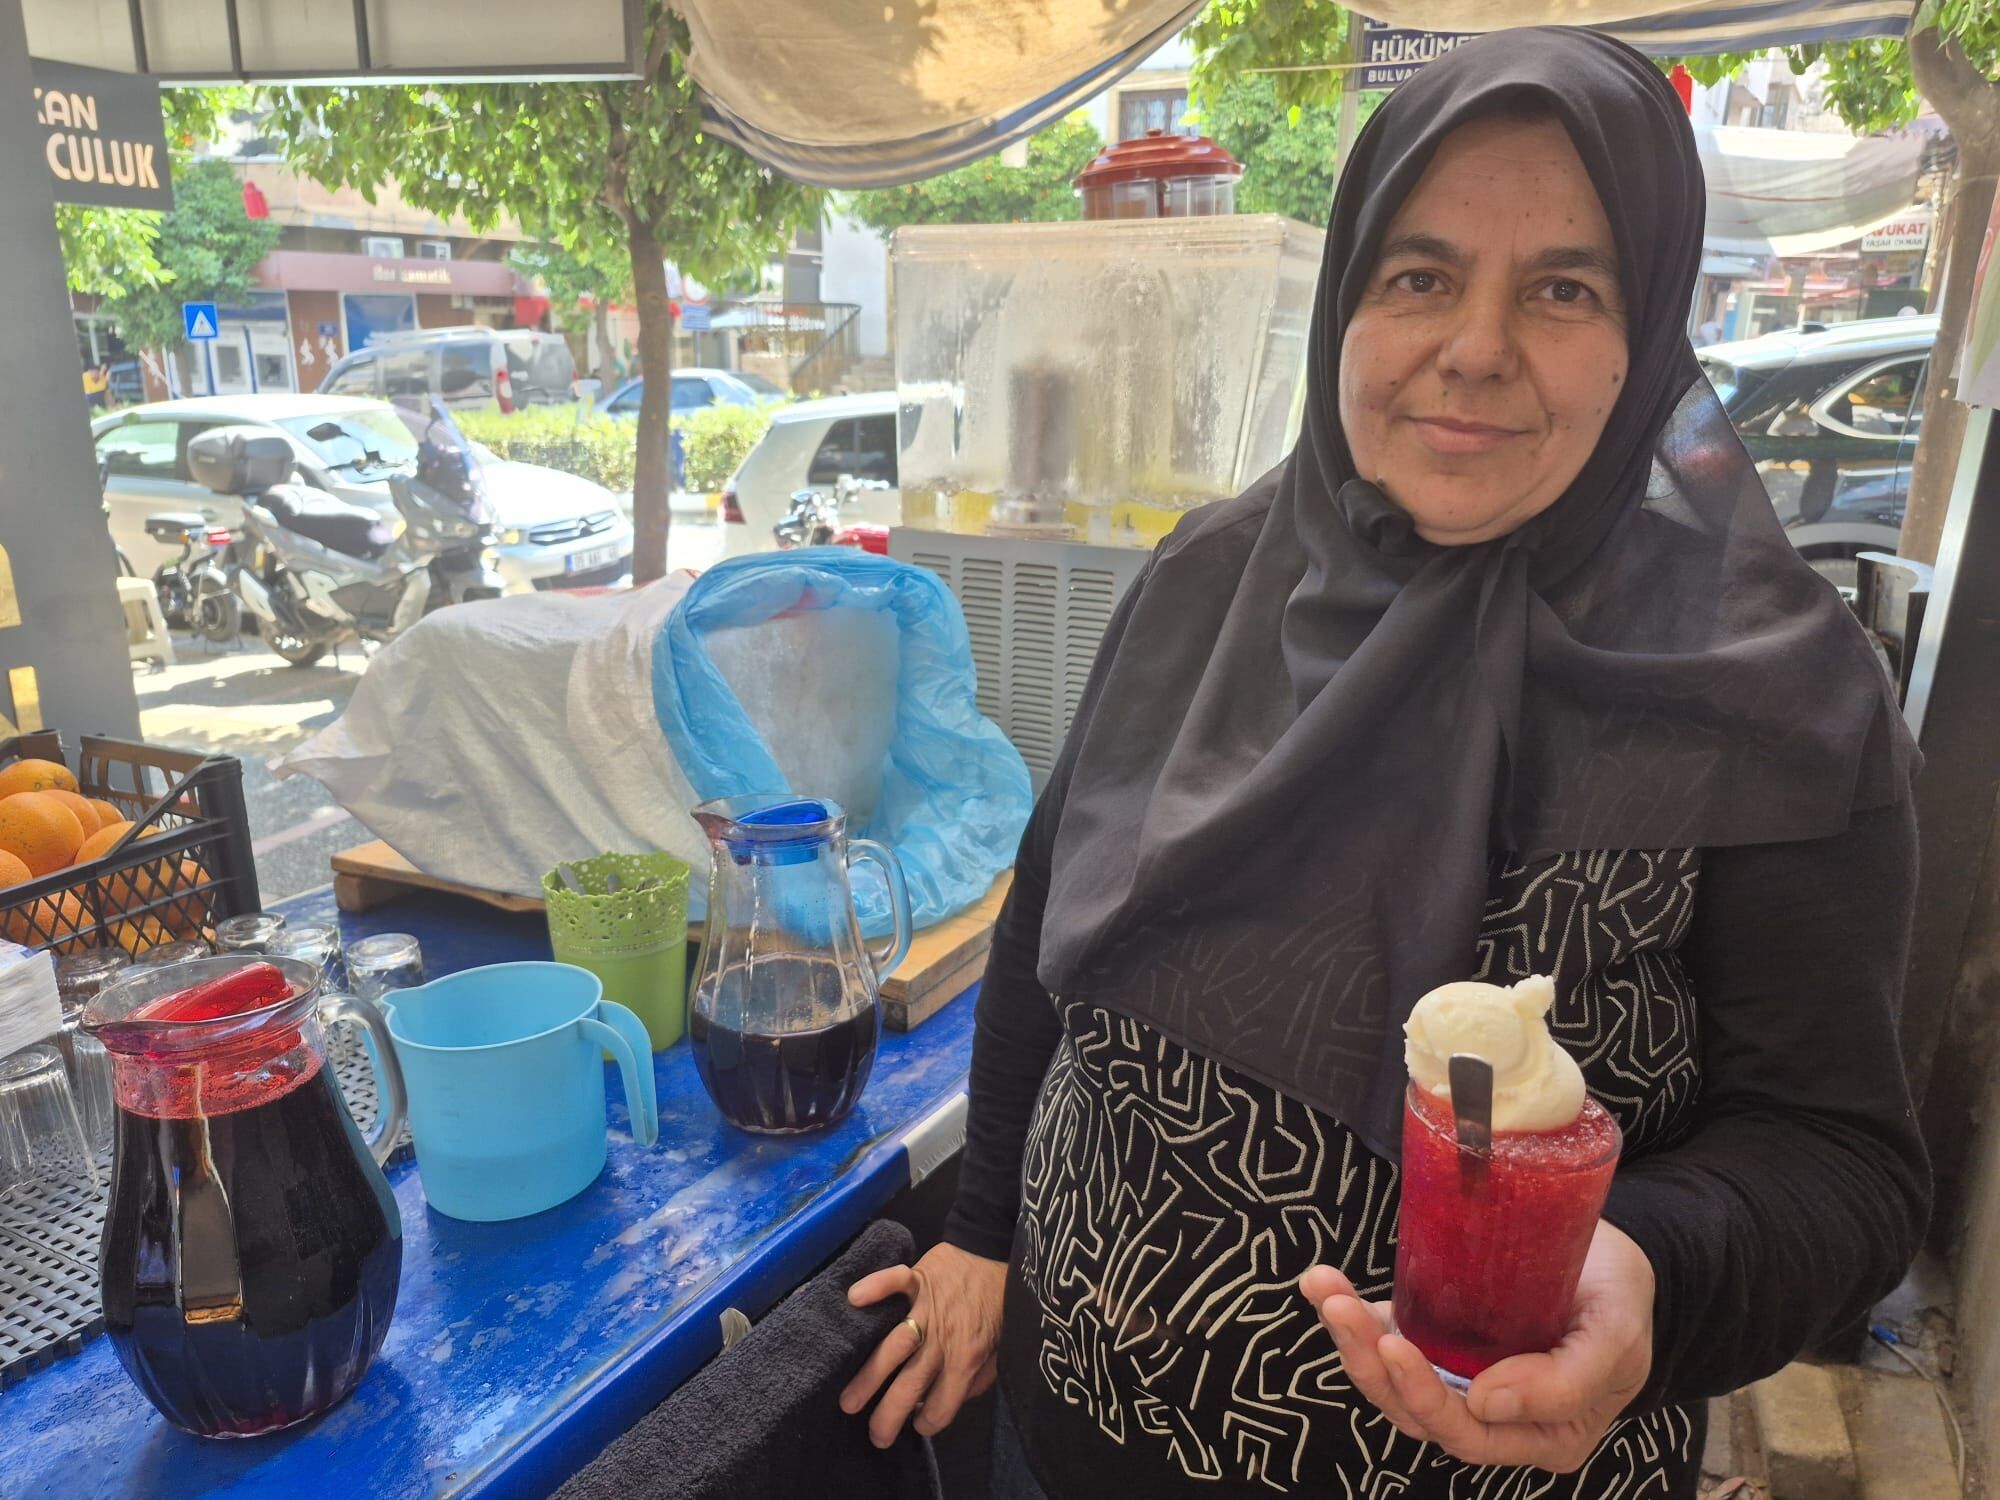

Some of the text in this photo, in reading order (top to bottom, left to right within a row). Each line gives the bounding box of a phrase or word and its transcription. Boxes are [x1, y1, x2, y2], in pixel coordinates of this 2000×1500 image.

[1371, 33, 1483, 62] HÜKÜM
[1367, 68, 1420, 83] BULVA
[46, 132, 160, 189] CULUK
